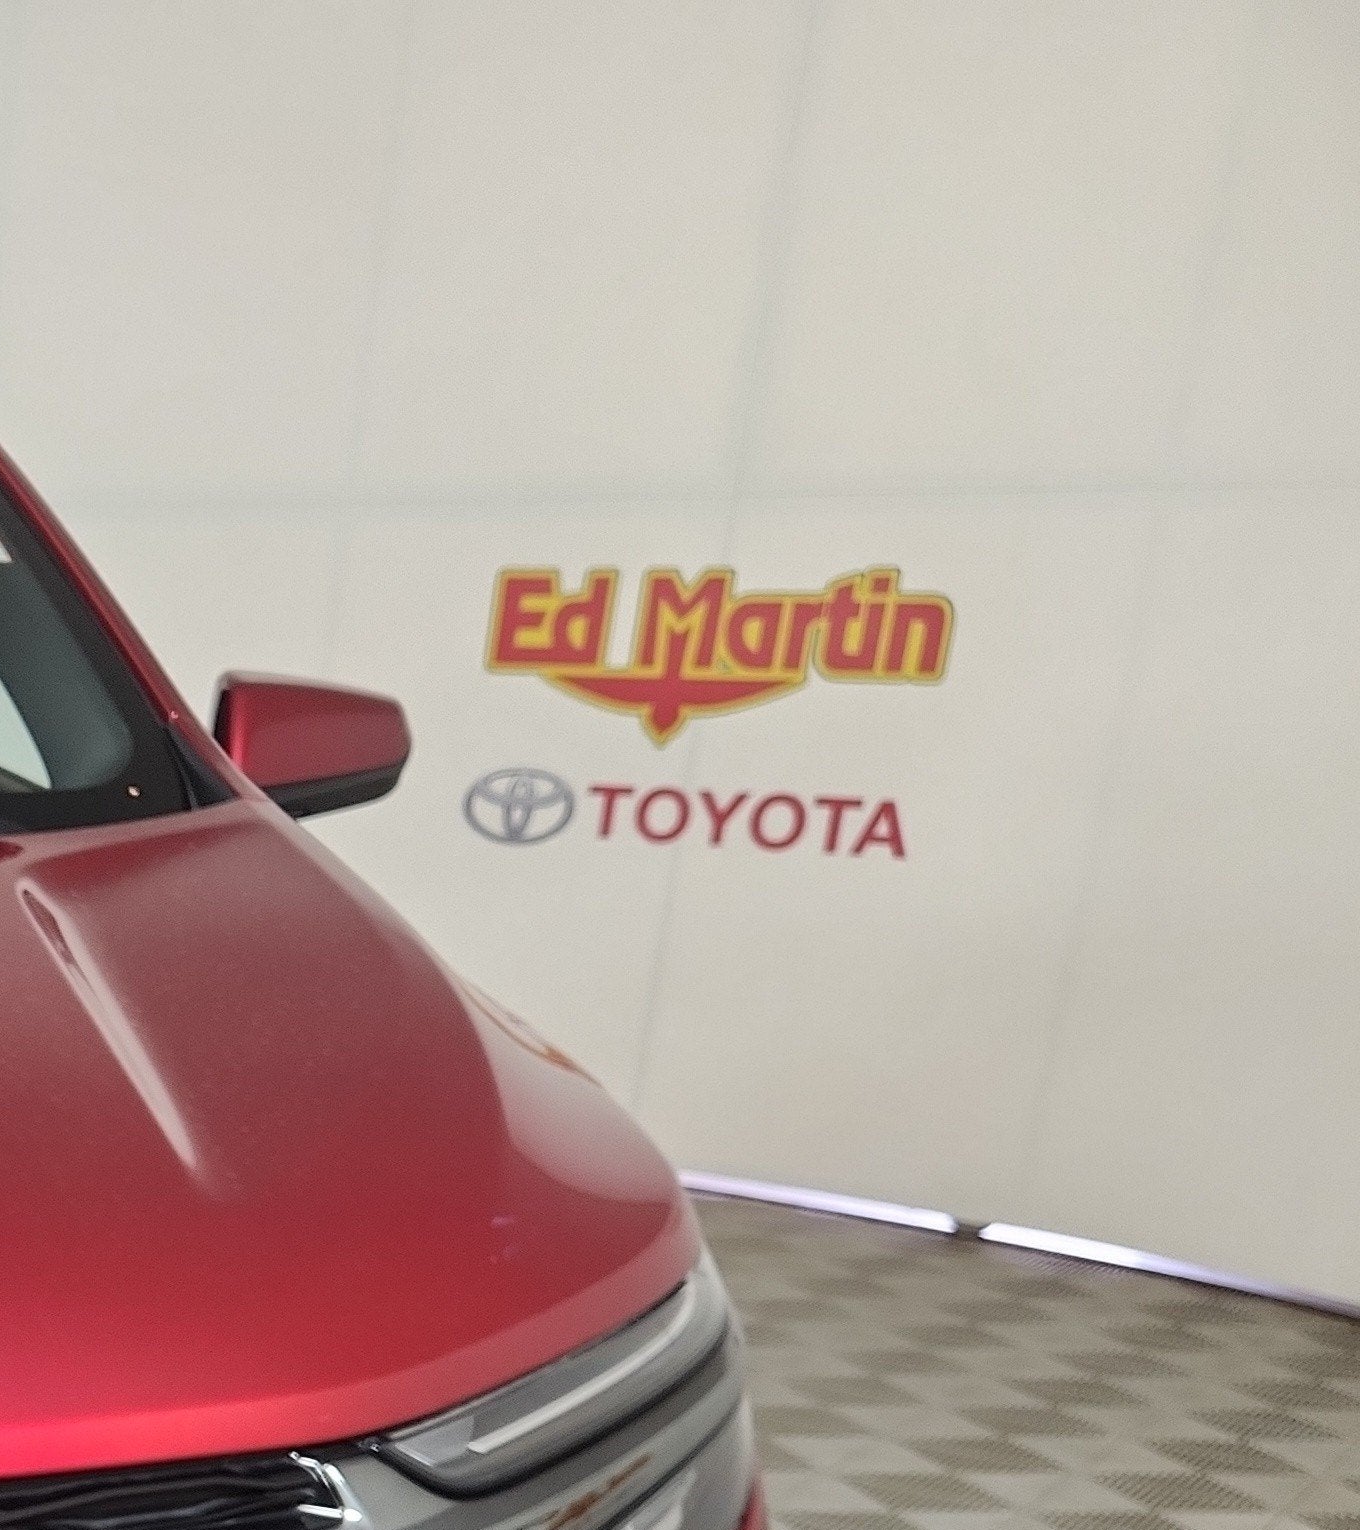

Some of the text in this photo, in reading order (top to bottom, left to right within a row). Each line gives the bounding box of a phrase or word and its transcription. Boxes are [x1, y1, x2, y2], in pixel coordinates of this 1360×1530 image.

[489, 570, 952, 682] Ed Martin
[587, 784, 907, 859] TOYOTA
